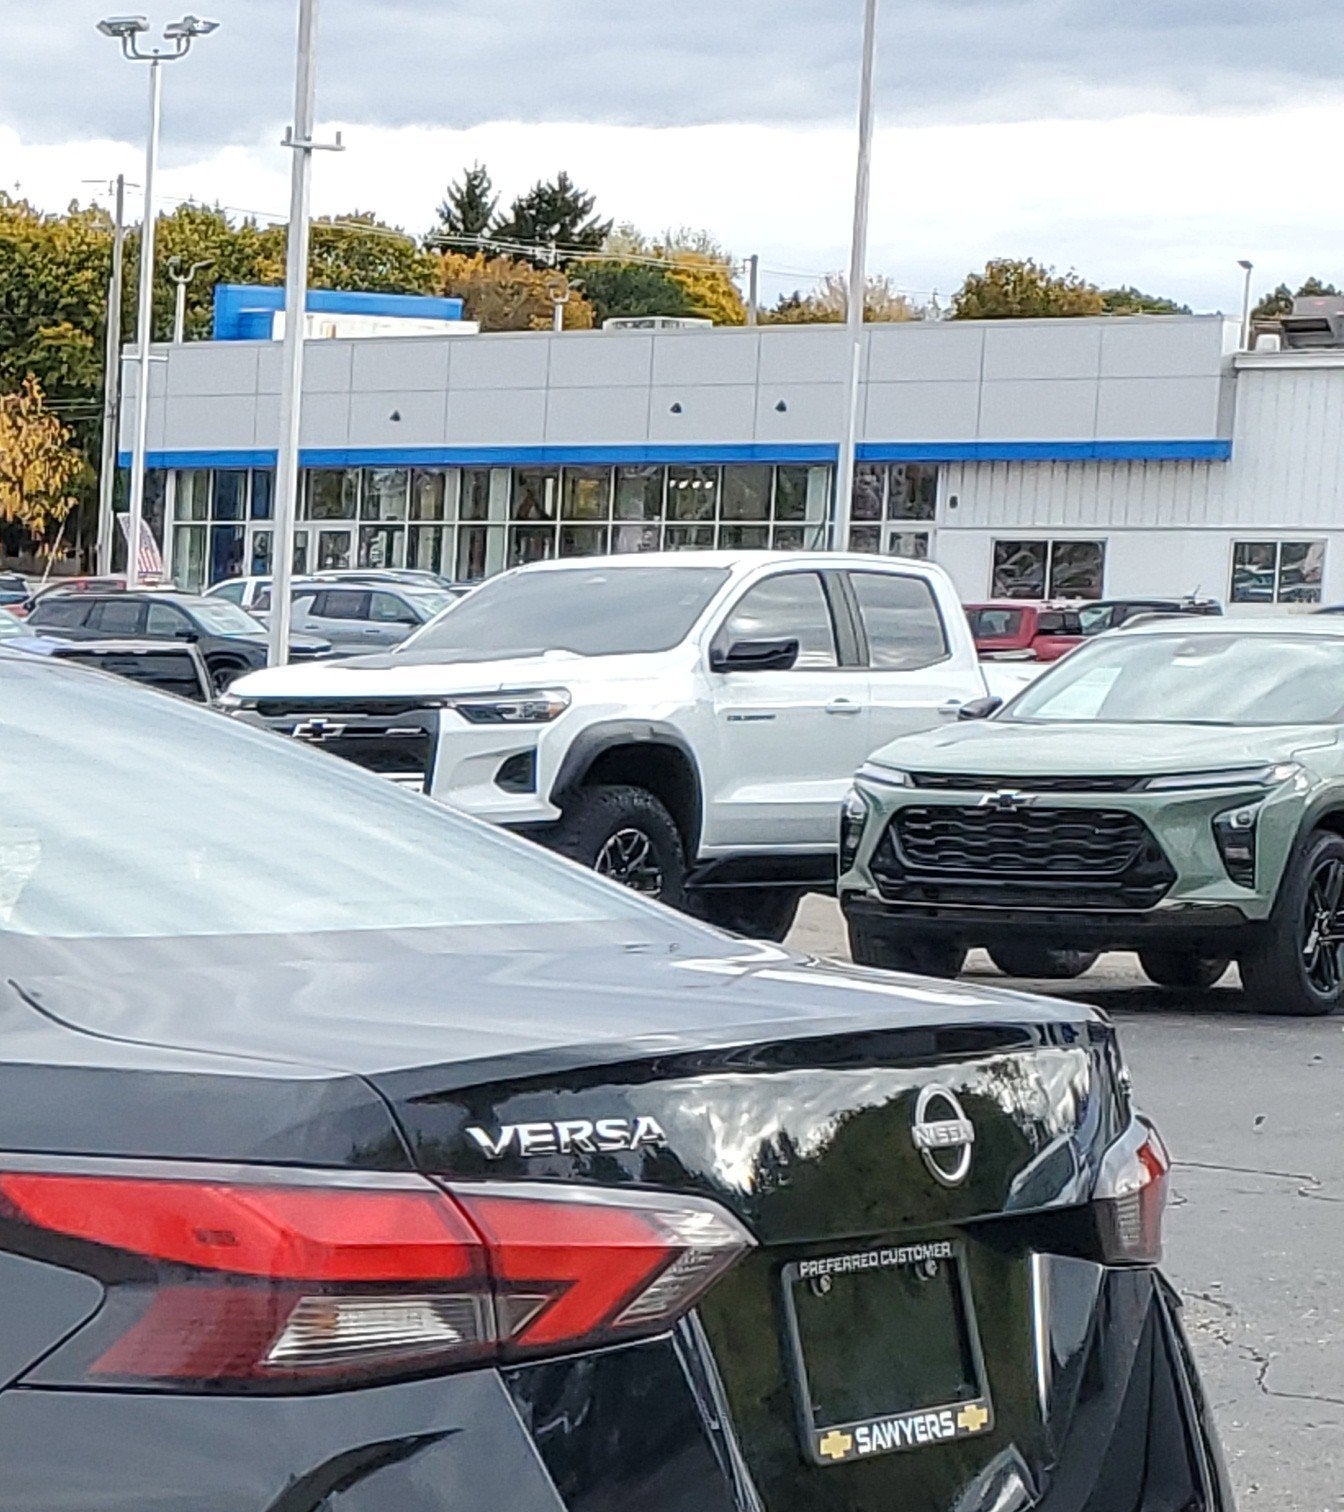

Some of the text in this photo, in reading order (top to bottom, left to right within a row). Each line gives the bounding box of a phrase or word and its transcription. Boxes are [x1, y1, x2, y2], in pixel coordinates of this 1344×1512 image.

[465, 1116, 669, 1159] VERSA
[800, 1241, 952, 1277] PREFERRED CUSTOMER
[855, 1411, 955, 1453] SAWYERS
